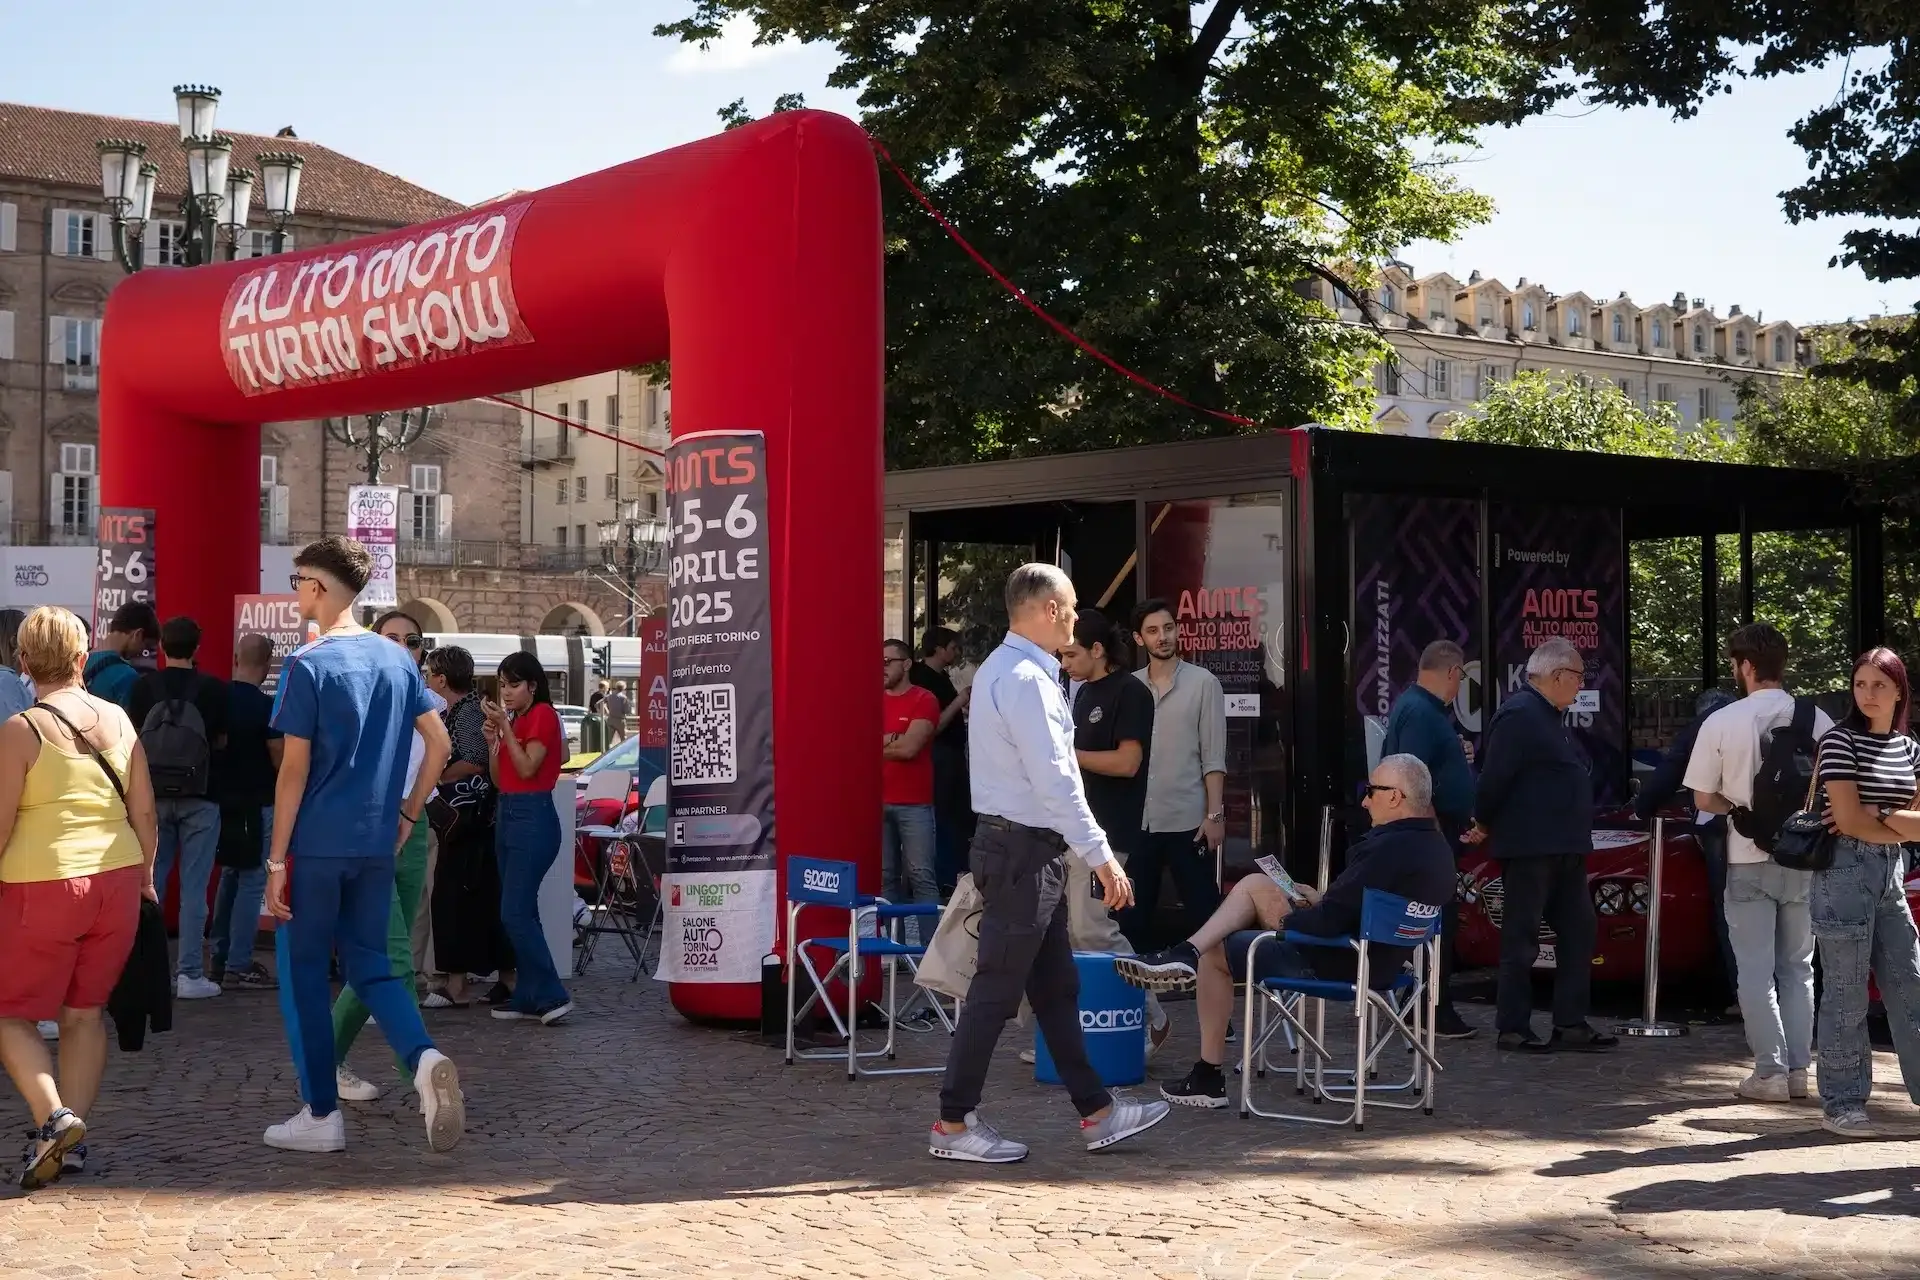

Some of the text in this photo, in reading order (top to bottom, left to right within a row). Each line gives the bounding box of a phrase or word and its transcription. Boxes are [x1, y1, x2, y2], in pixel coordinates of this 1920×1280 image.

[228, 214, 507, 329] AUTO MOTO
[229, 275, 511, 388] TURIN SHOW
[358, 491, 391, 499] SALONE
[357, 517, 389, 526] 2024
[367, 545, 389, 553] LONE
[1507, 548, 1555, 564] Powered
[1556, 551, 1570, 568] by
[671, 590, 733, 628] 2025
[1176, 586, 1262, 620] AMTS
[1522, 588, 1599, 619] AMTS
[238, 601, 302, 629] AMTS
[1178, 621, 1216, 637] AUTO
[1522, 621, 1599, 635] AUTO MOTO
[687, 633, 713, 645] FIERE
[715, 630, 760, 642] TORINO
[1177, 634, 1261, 651] TURIN SHOW
[1377, 581, 1390, 728] SONALIZZATI
[672, 663, 731, 678] scopri l'evento
[1239, 660, 1261, 672] 2025
[1238, 704, 1256, 712] rooms
[675, 805, 728, 816] MAIN PARTNER
[803, 868, 840, 890] sparco
[686, 882, 741, 896] LINGOTTO
[698, 894, 724, 907] FIERE
[682, 917, 716, 928] SALONE
[683, 953, 718, 966] 2024
[1078, 1007, 1143, 1033] parco
